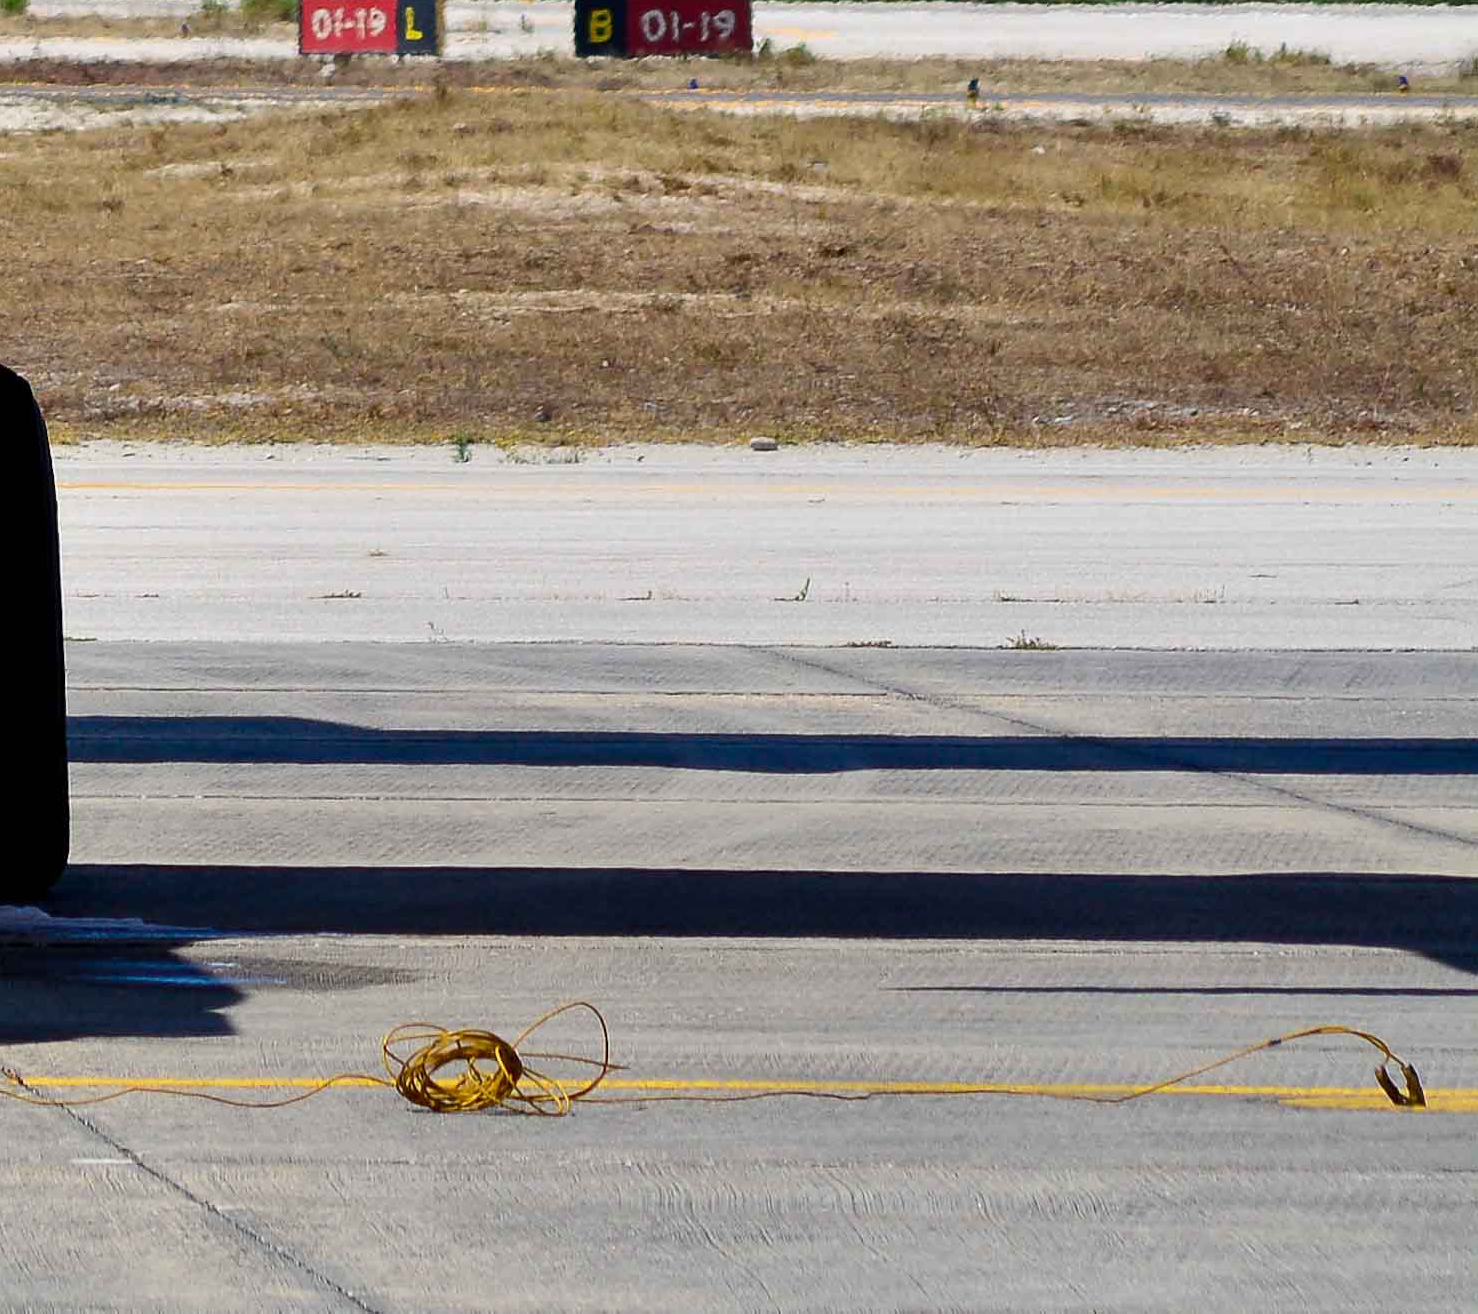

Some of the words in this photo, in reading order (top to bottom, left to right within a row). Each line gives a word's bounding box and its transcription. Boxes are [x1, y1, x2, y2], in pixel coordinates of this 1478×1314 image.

[311, 5, 388, 41] 01-19
[405, 6, 424, 41] L
[590, 8, 613, 43] B
[640, 9, 736, 43] 01-19
